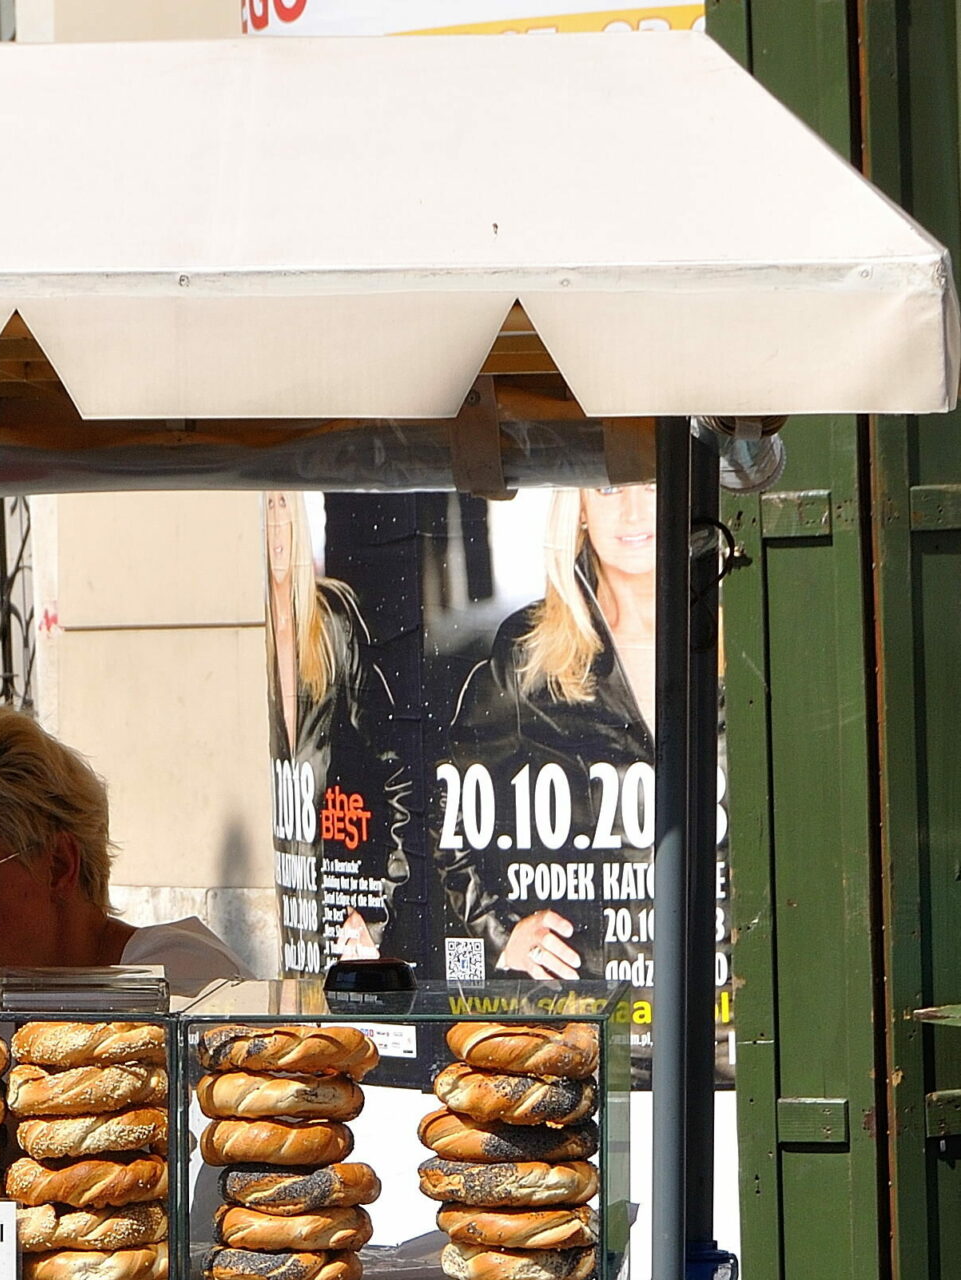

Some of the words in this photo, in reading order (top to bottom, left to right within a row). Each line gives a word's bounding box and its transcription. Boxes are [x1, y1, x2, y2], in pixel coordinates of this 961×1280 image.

[325, 785, 364, 813] the
[321, 809, 371, 849] BEST
[507, 863, 594, 900] SPODEK
